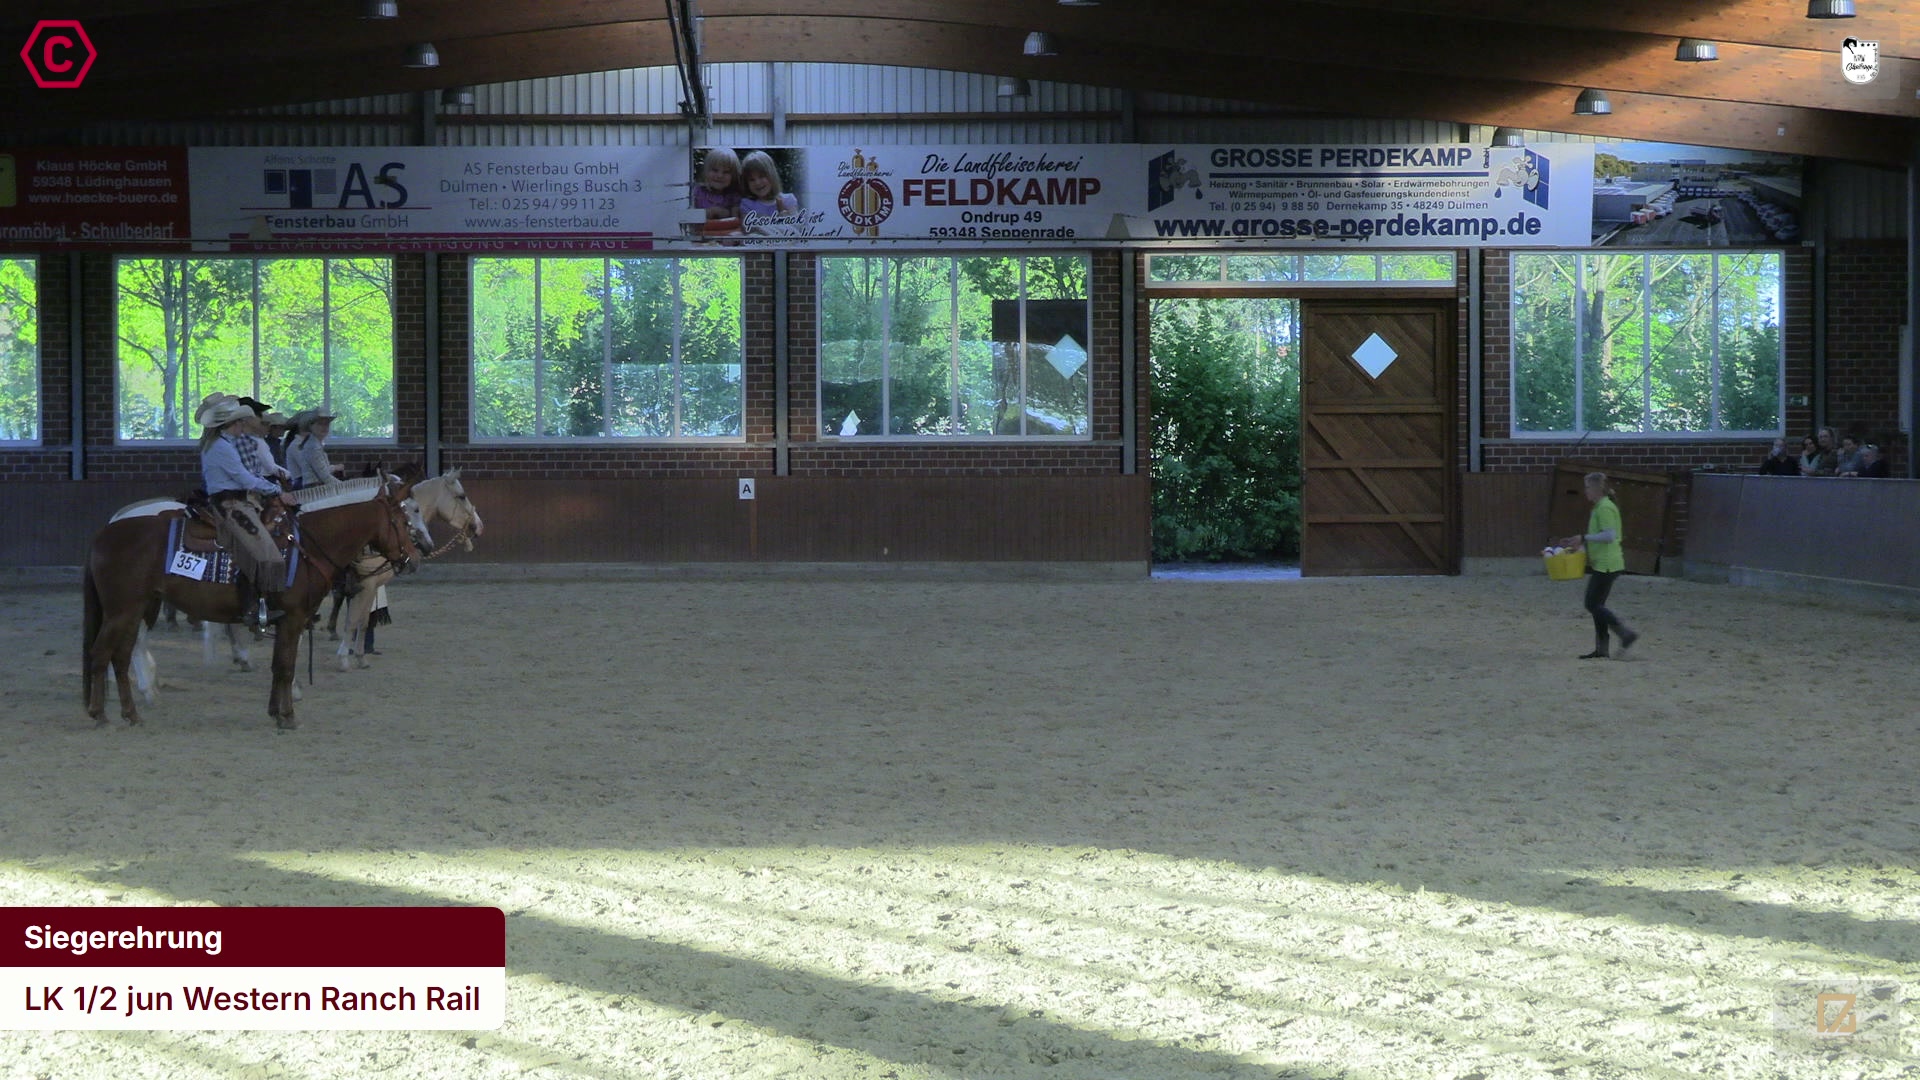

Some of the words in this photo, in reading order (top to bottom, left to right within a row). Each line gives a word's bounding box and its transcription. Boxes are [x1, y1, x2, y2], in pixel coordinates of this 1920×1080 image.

[1210, 148, 1313, 168] GROSSE
[1320, 147, 1472, 168] PERDEKAMP
[36, 160, 74, 172] Klaus
[79, 159, 121, 172] Höcke
[125, 160, 168, 172] GmbH
[464, 162, 482, 175] AS
[487, 161, 569, 176] Fensterbau
[574, 162, 619, 175] GmbH
[921, 153, 950, 174] Die
[953, 152, 1084, 180] Landfleischerei
[32, 176, 72, 188] 59348
[76, 176, 172, 190] Lüdinghausen
[338, 162, 409, 209] AS
[440, 179, 498, 193] Dülmen
[512, 179, 579, 196] Wierlings
[584, 179, 628, 193] Busch
[633, 180, 642, 192] 3
[1209, 180, 1247, 190] Heizung
[1255, 180, 1288, 189] Sanitär
[1296, 180, 1353, 189] Brunnenbau
[1361, 180, 1385, 188] Solar
[1393, 179, 1490, 189] Erdwärmebohrungen
[28, 192, 178, 204] www.hoecke-buero.de
[903, 177, 1101, 207] FELDKAMP
[1229, 190, 1298, 200] Wärmepumpen
[1307, 189, 1322, 199] Öl-
[1323, 191, 1341, 199] und
[1343, 190, 1470, 200] Gasfeuerungskundendienst
[469, 198, 497, 210] Tel.:
[839, 197, 893, 226] FELDKAMP
[1209, 202, 1227, 211] Tel.
[1326, 201, 1388, 212] Dernekamp
[1390, 201, 1403, 210] 35
[1413, 200, 1444, 210] 48249
[1447, 200, 1489, 210] Dülmen
[265, 214, 356, 229] Fensterbau
[360, 214, 409, 229] GmbH
[464, 214, 620, 228] www.as-fensterbau.de
[744, 208, 804, 232] Geschmack
[808, 211, 825, 224] ist
[961, 211, 1020, 226] Ondrup
[1023, 211, 1042, 223] 49
[80, 221, 175, 239] Schulbedarf
[929, 227, 977, 238] 59348
[1154, 212, 1542, 241] www.grosse-perdekamp.de
[742, 483, 752, 494] A
[176, 554, 201, 572] 357
